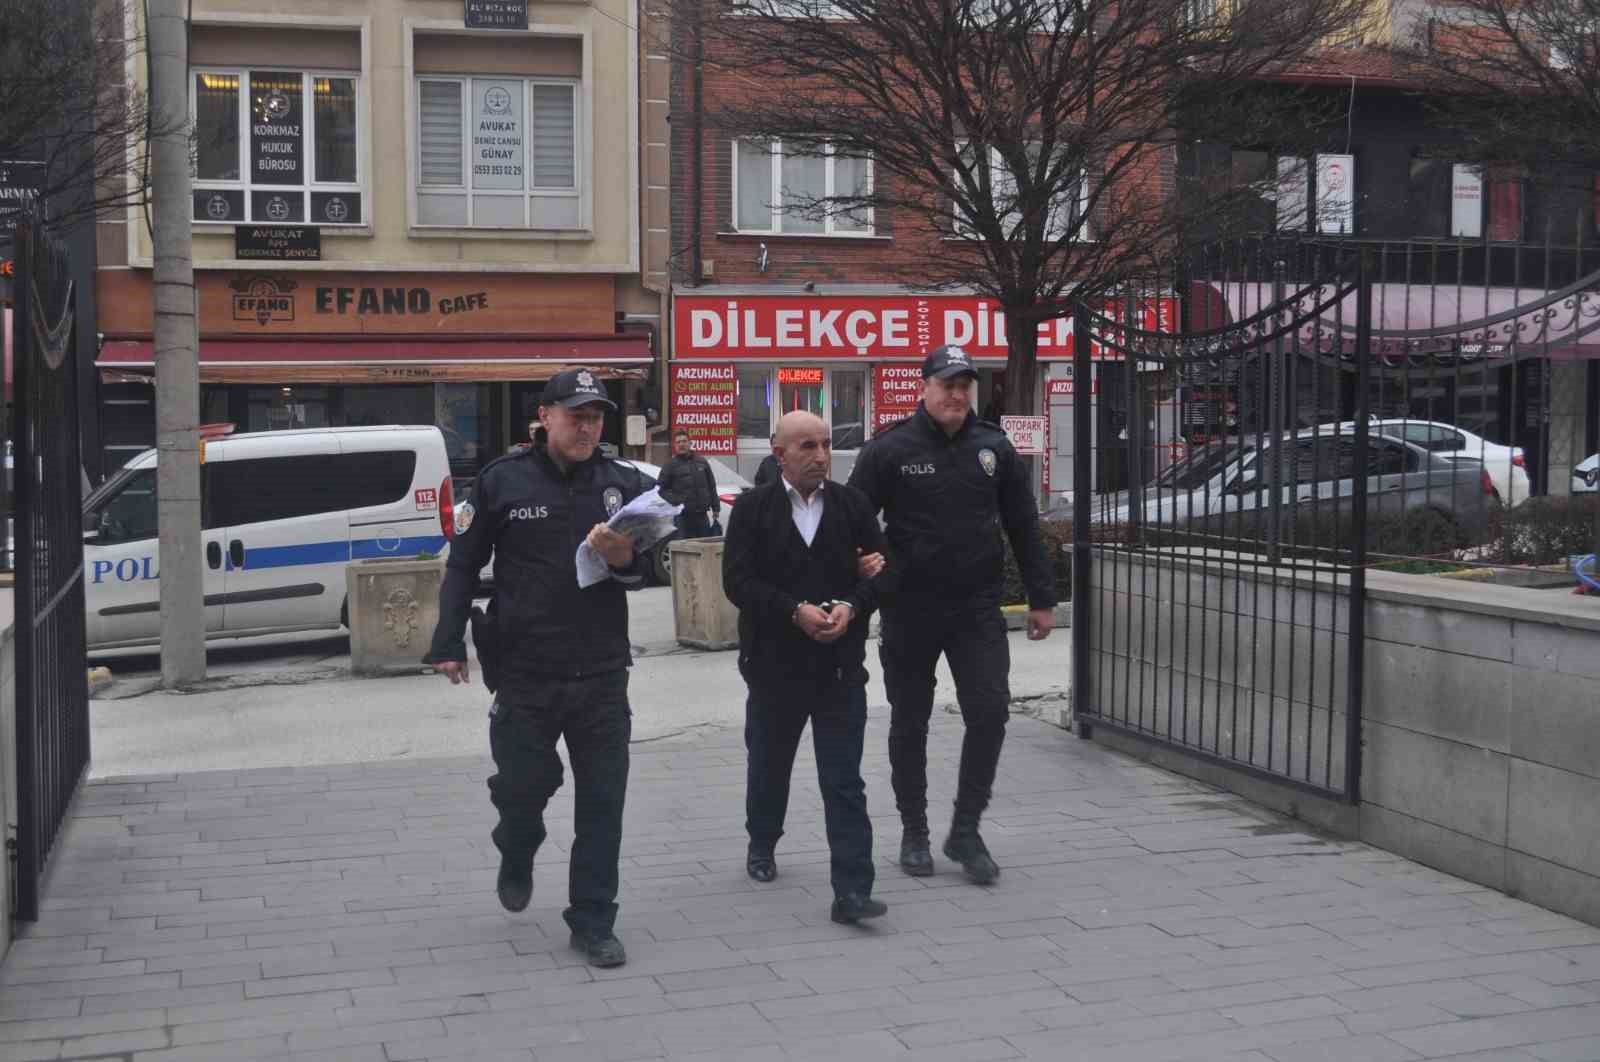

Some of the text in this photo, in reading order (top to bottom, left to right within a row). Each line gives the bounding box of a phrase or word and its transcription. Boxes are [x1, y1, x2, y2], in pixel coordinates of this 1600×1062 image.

[254, 125, 300, 137] KORKMAZ
[480, 121, 516, 131] AVUKAT
[261, 142, 293, 153] HUKUK
[481, 147, 514, 159] GÜNAY
[259, 156, 296, 170] BÜROSU
[251, 229, 305, 239] AVUKAT
[239, 299, 289, 311] EFANO
[315, 287, 489, 315] EFANO CAFE
[690, 301, 910, 355] DİLEKÇE
[676, 364, 734, 379] ARZUHALCİ
[882, 368, 922, 378] FOTOKO
[882, 379, 917, 390] DİLEK
[676, 392, 734, 406] ARZUHALCİ
[675, 410, 733, 425] ARZUHALCİ
[1005, 419, 1042, 431] OTOPARK
[689, 437, 733, 452] ZUHALCİ
[417, 490, 433, 502] 112
[92, 556, 160, 584] POL
